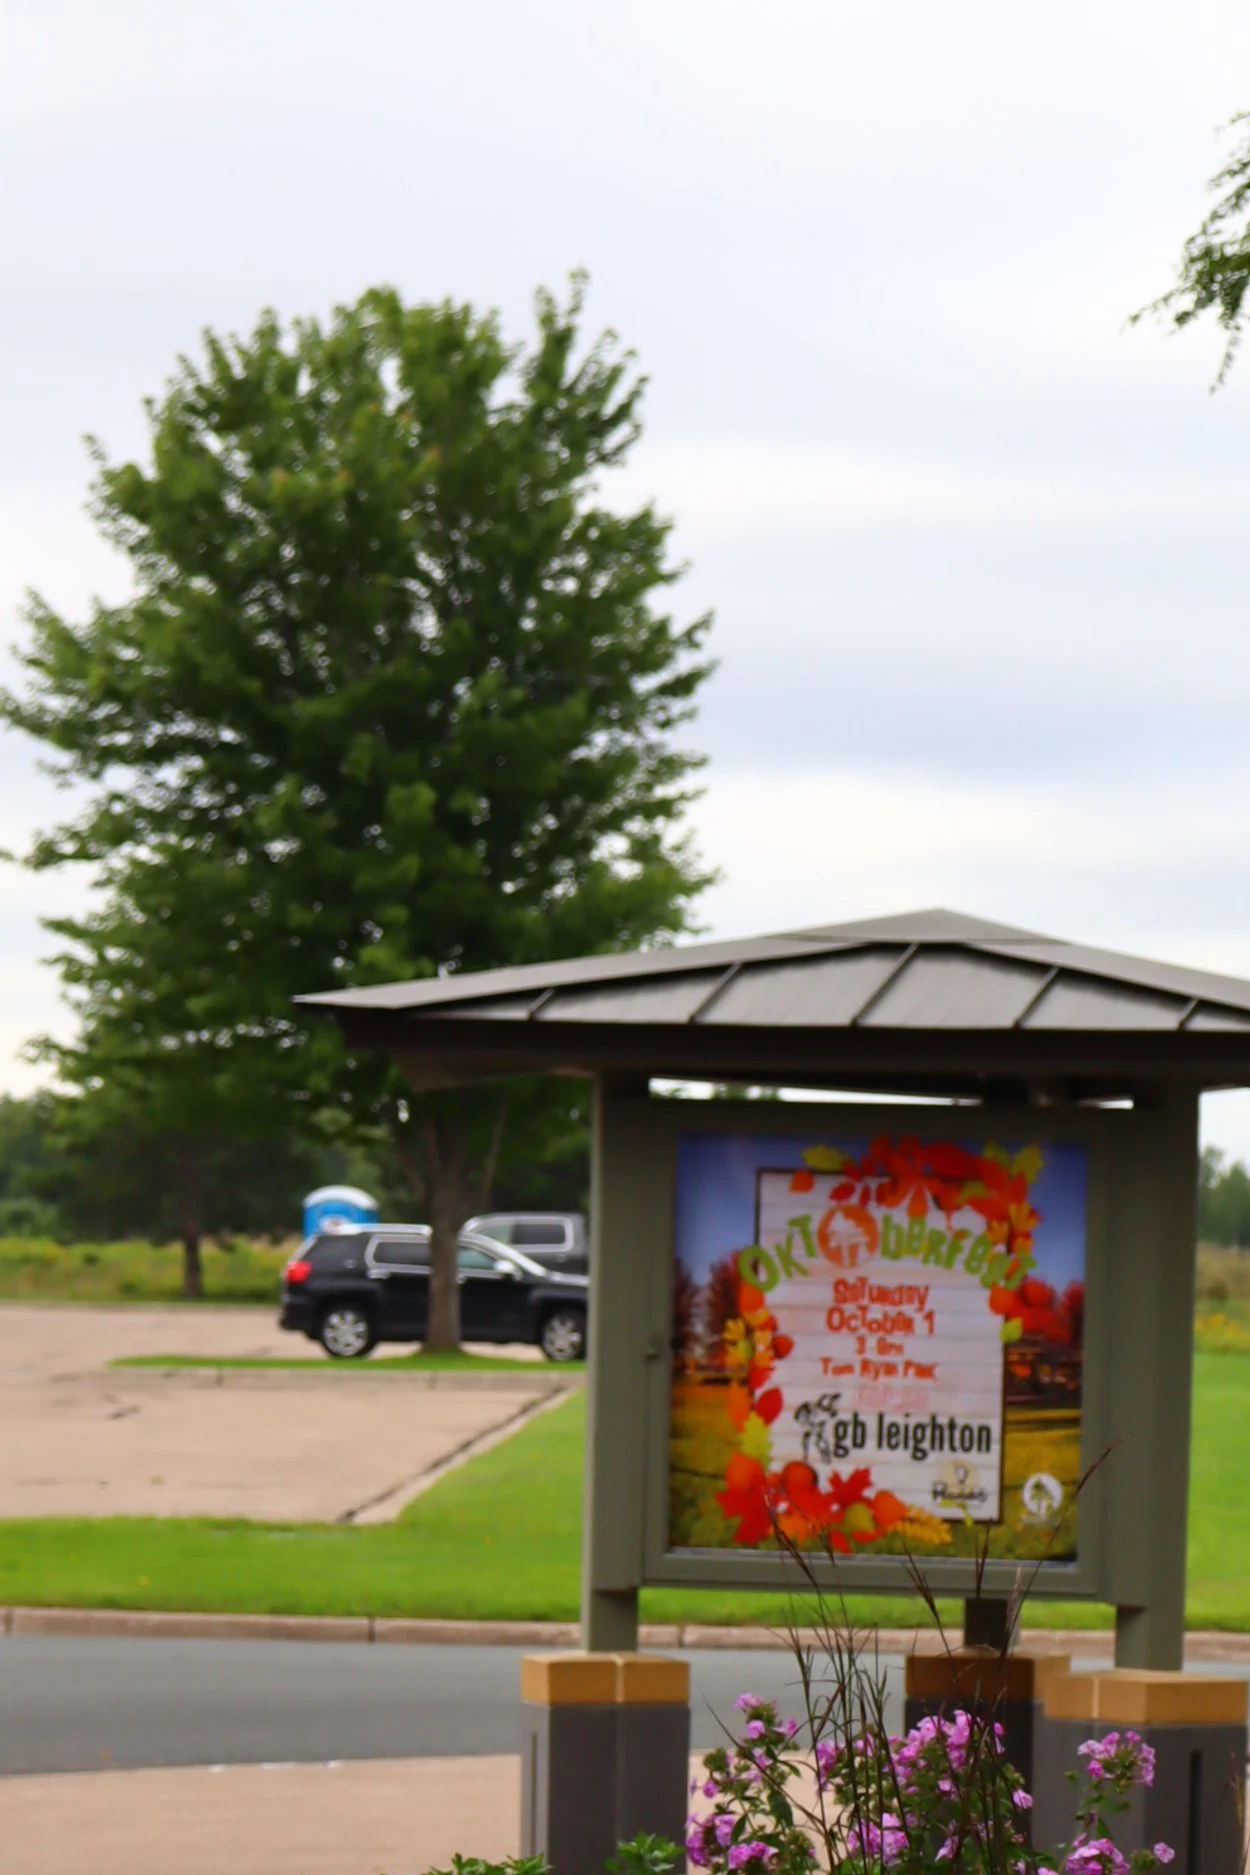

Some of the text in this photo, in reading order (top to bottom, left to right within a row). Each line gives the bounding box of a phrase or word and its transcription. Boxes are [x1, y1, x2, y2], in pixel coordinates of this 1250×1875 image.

[924, 1310, 935, 1335] 1
[833, 1411, 992, 1461] gb leighton
